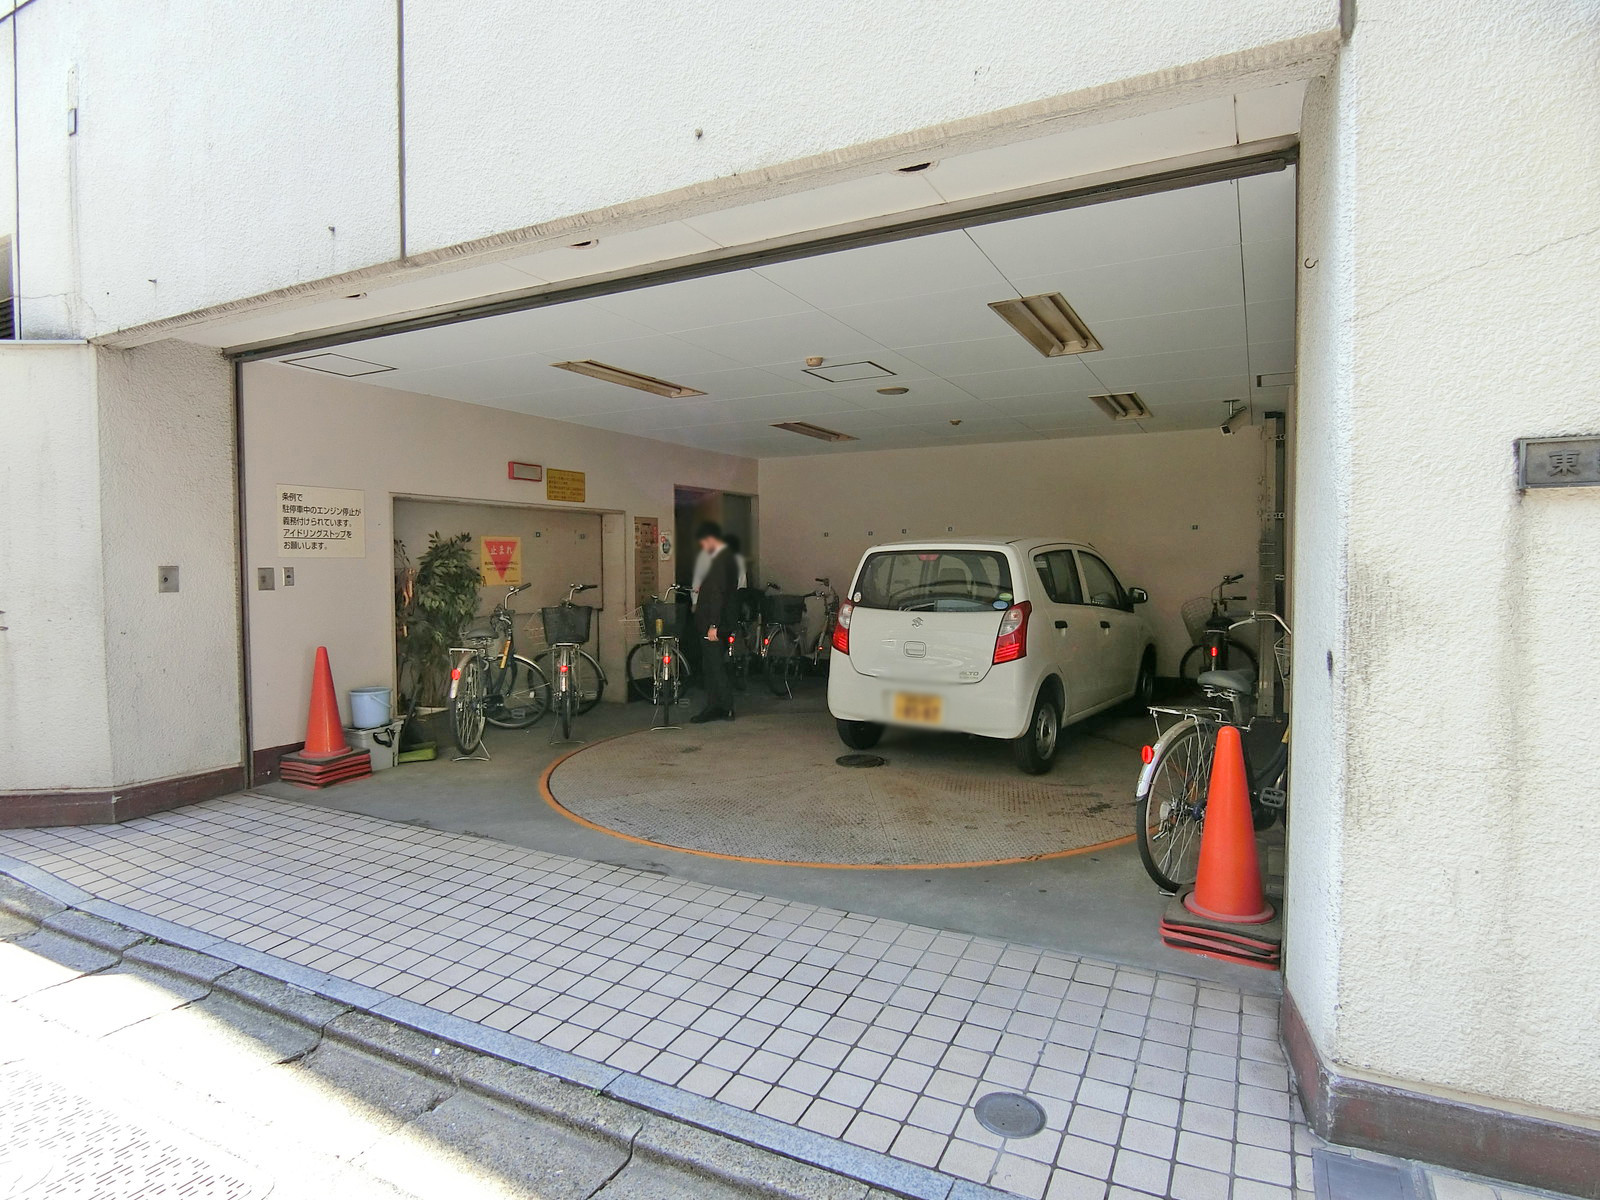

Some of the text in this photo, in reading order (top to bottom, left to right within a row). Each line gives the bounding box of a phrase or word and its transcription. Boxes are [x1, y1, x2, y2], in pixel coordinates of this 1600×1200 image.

[282, 492, 303, 502] 条例で
[282, 504, 361, 517] 駐停車中のエンジン停止が
[283, 516, 352, 528] 義務付けられています。
[283, 528, 352, 539] アイドリングストップを
[283, 541, 327, 551] お願いします。
